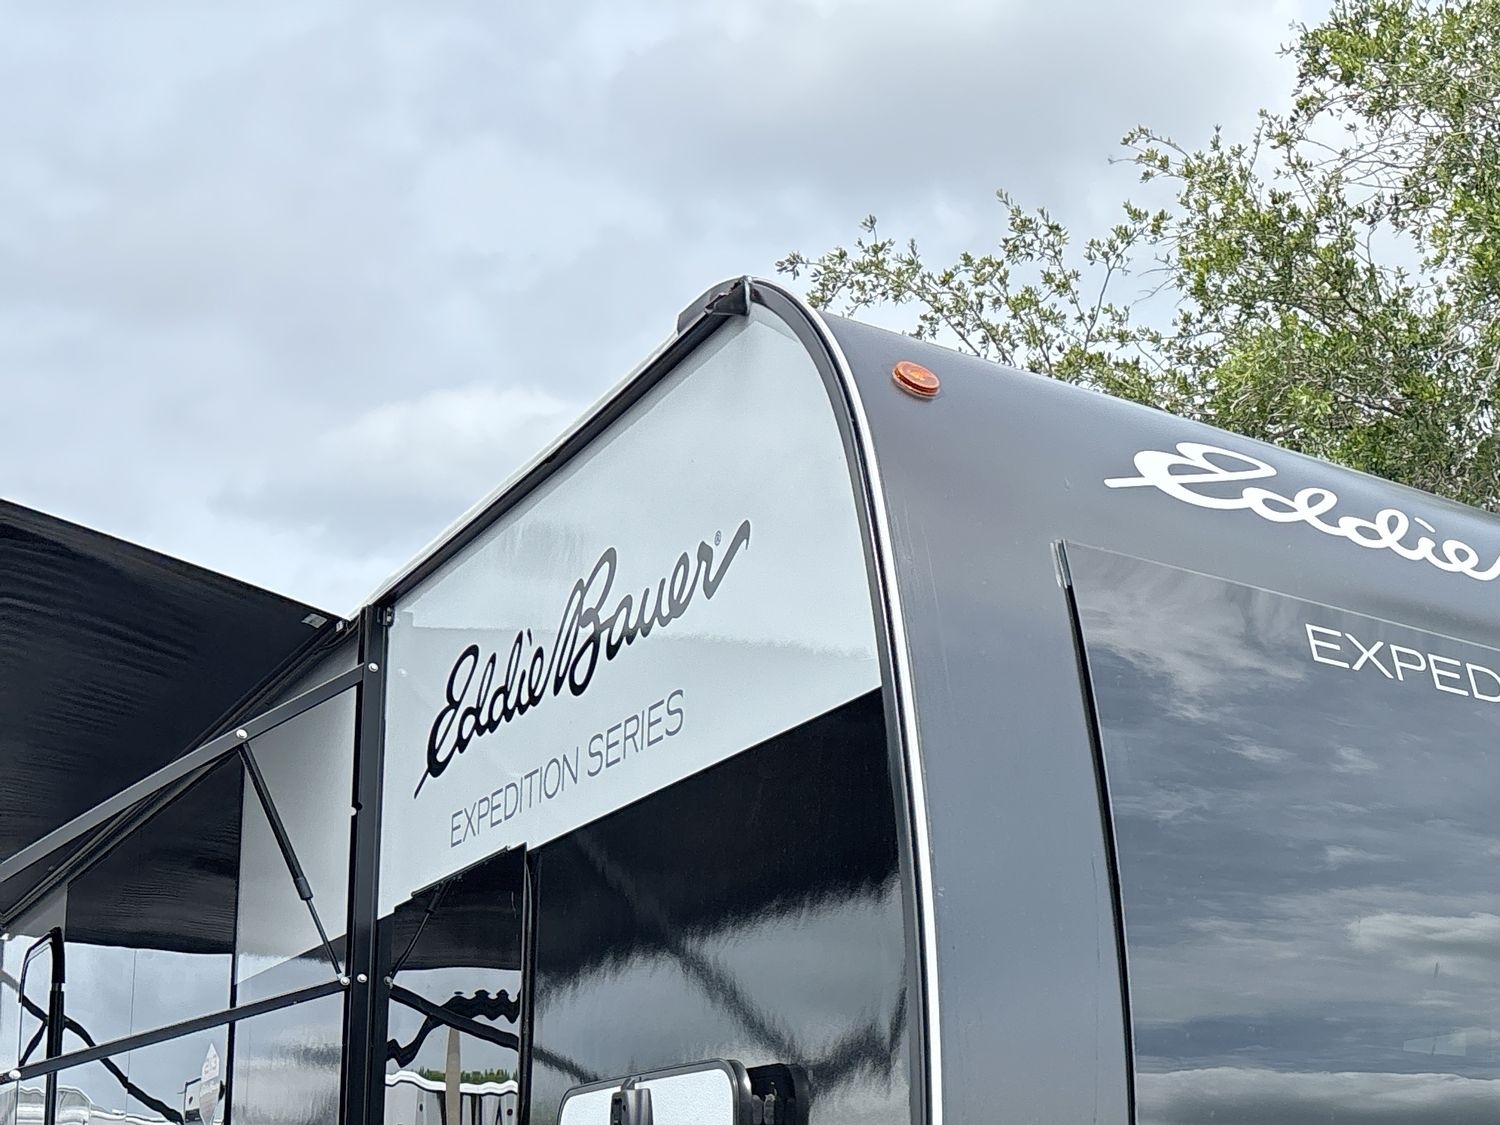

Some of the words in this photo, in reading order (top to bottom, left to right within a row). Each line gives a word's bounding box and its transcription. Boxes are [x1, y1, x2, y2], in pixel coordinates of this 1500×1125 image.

[414, 630, 558, 800] Eddie
[450, 749, 579, 849] EXPEDITION
[587, 688, 685, 779] SERIES
